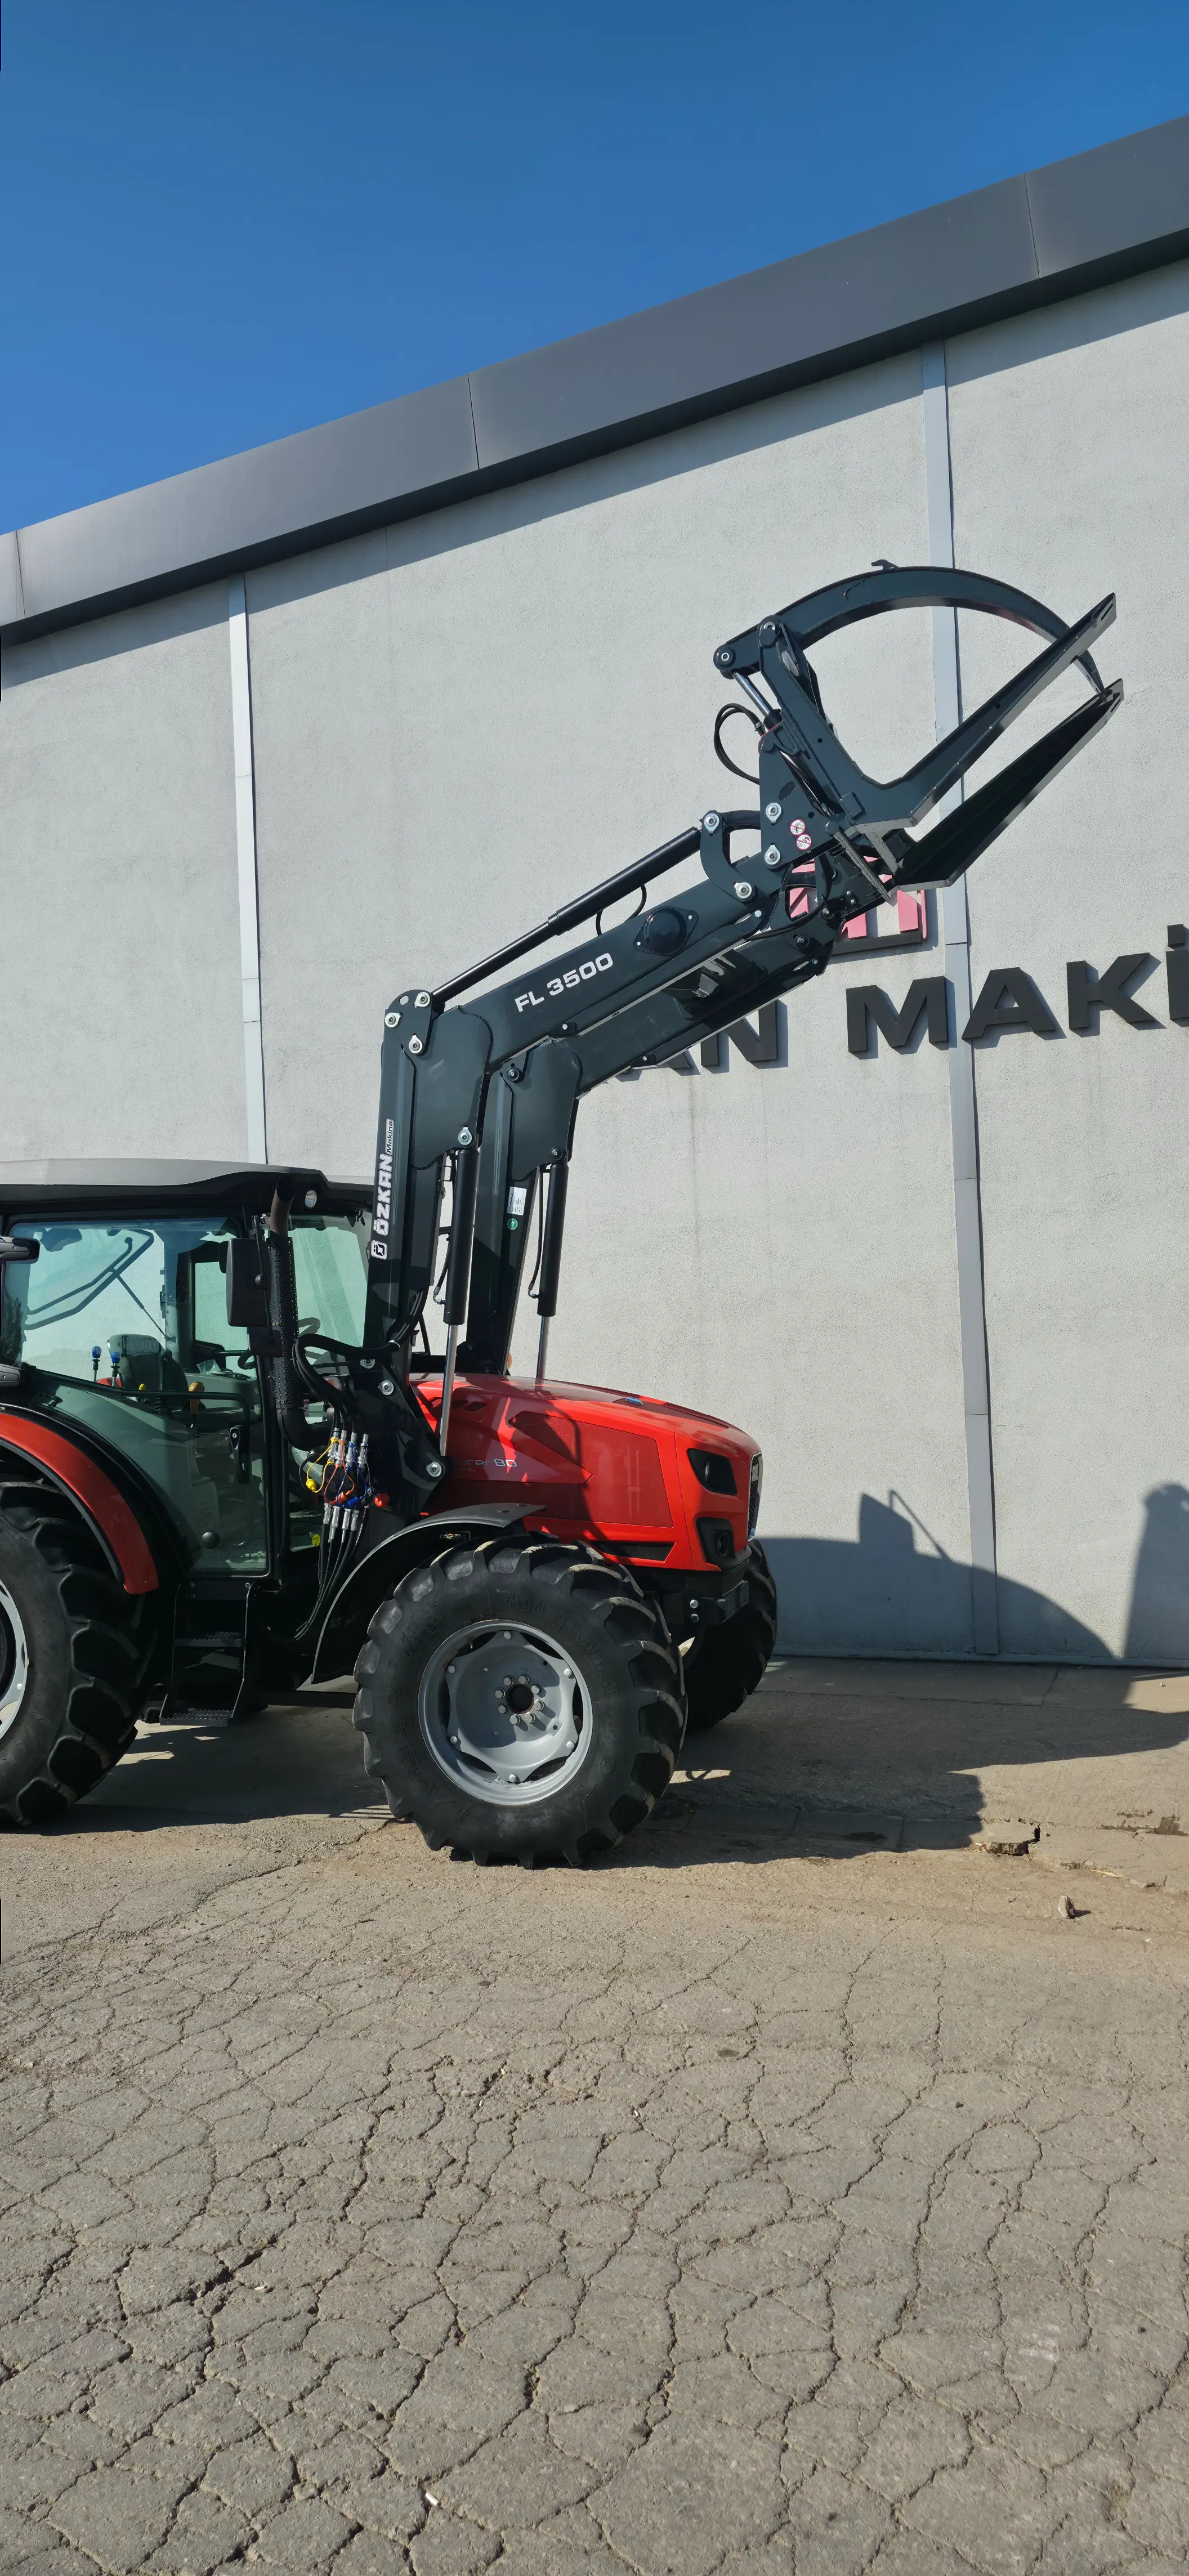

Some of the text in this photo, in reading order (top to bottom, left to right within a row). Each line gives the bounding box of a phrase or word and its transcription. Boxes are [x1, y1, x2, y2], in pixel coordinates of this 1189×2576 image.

[515, 952, 614, 1013] FL 3500
[373, 1153, 393, 1236] ÖZKAN
